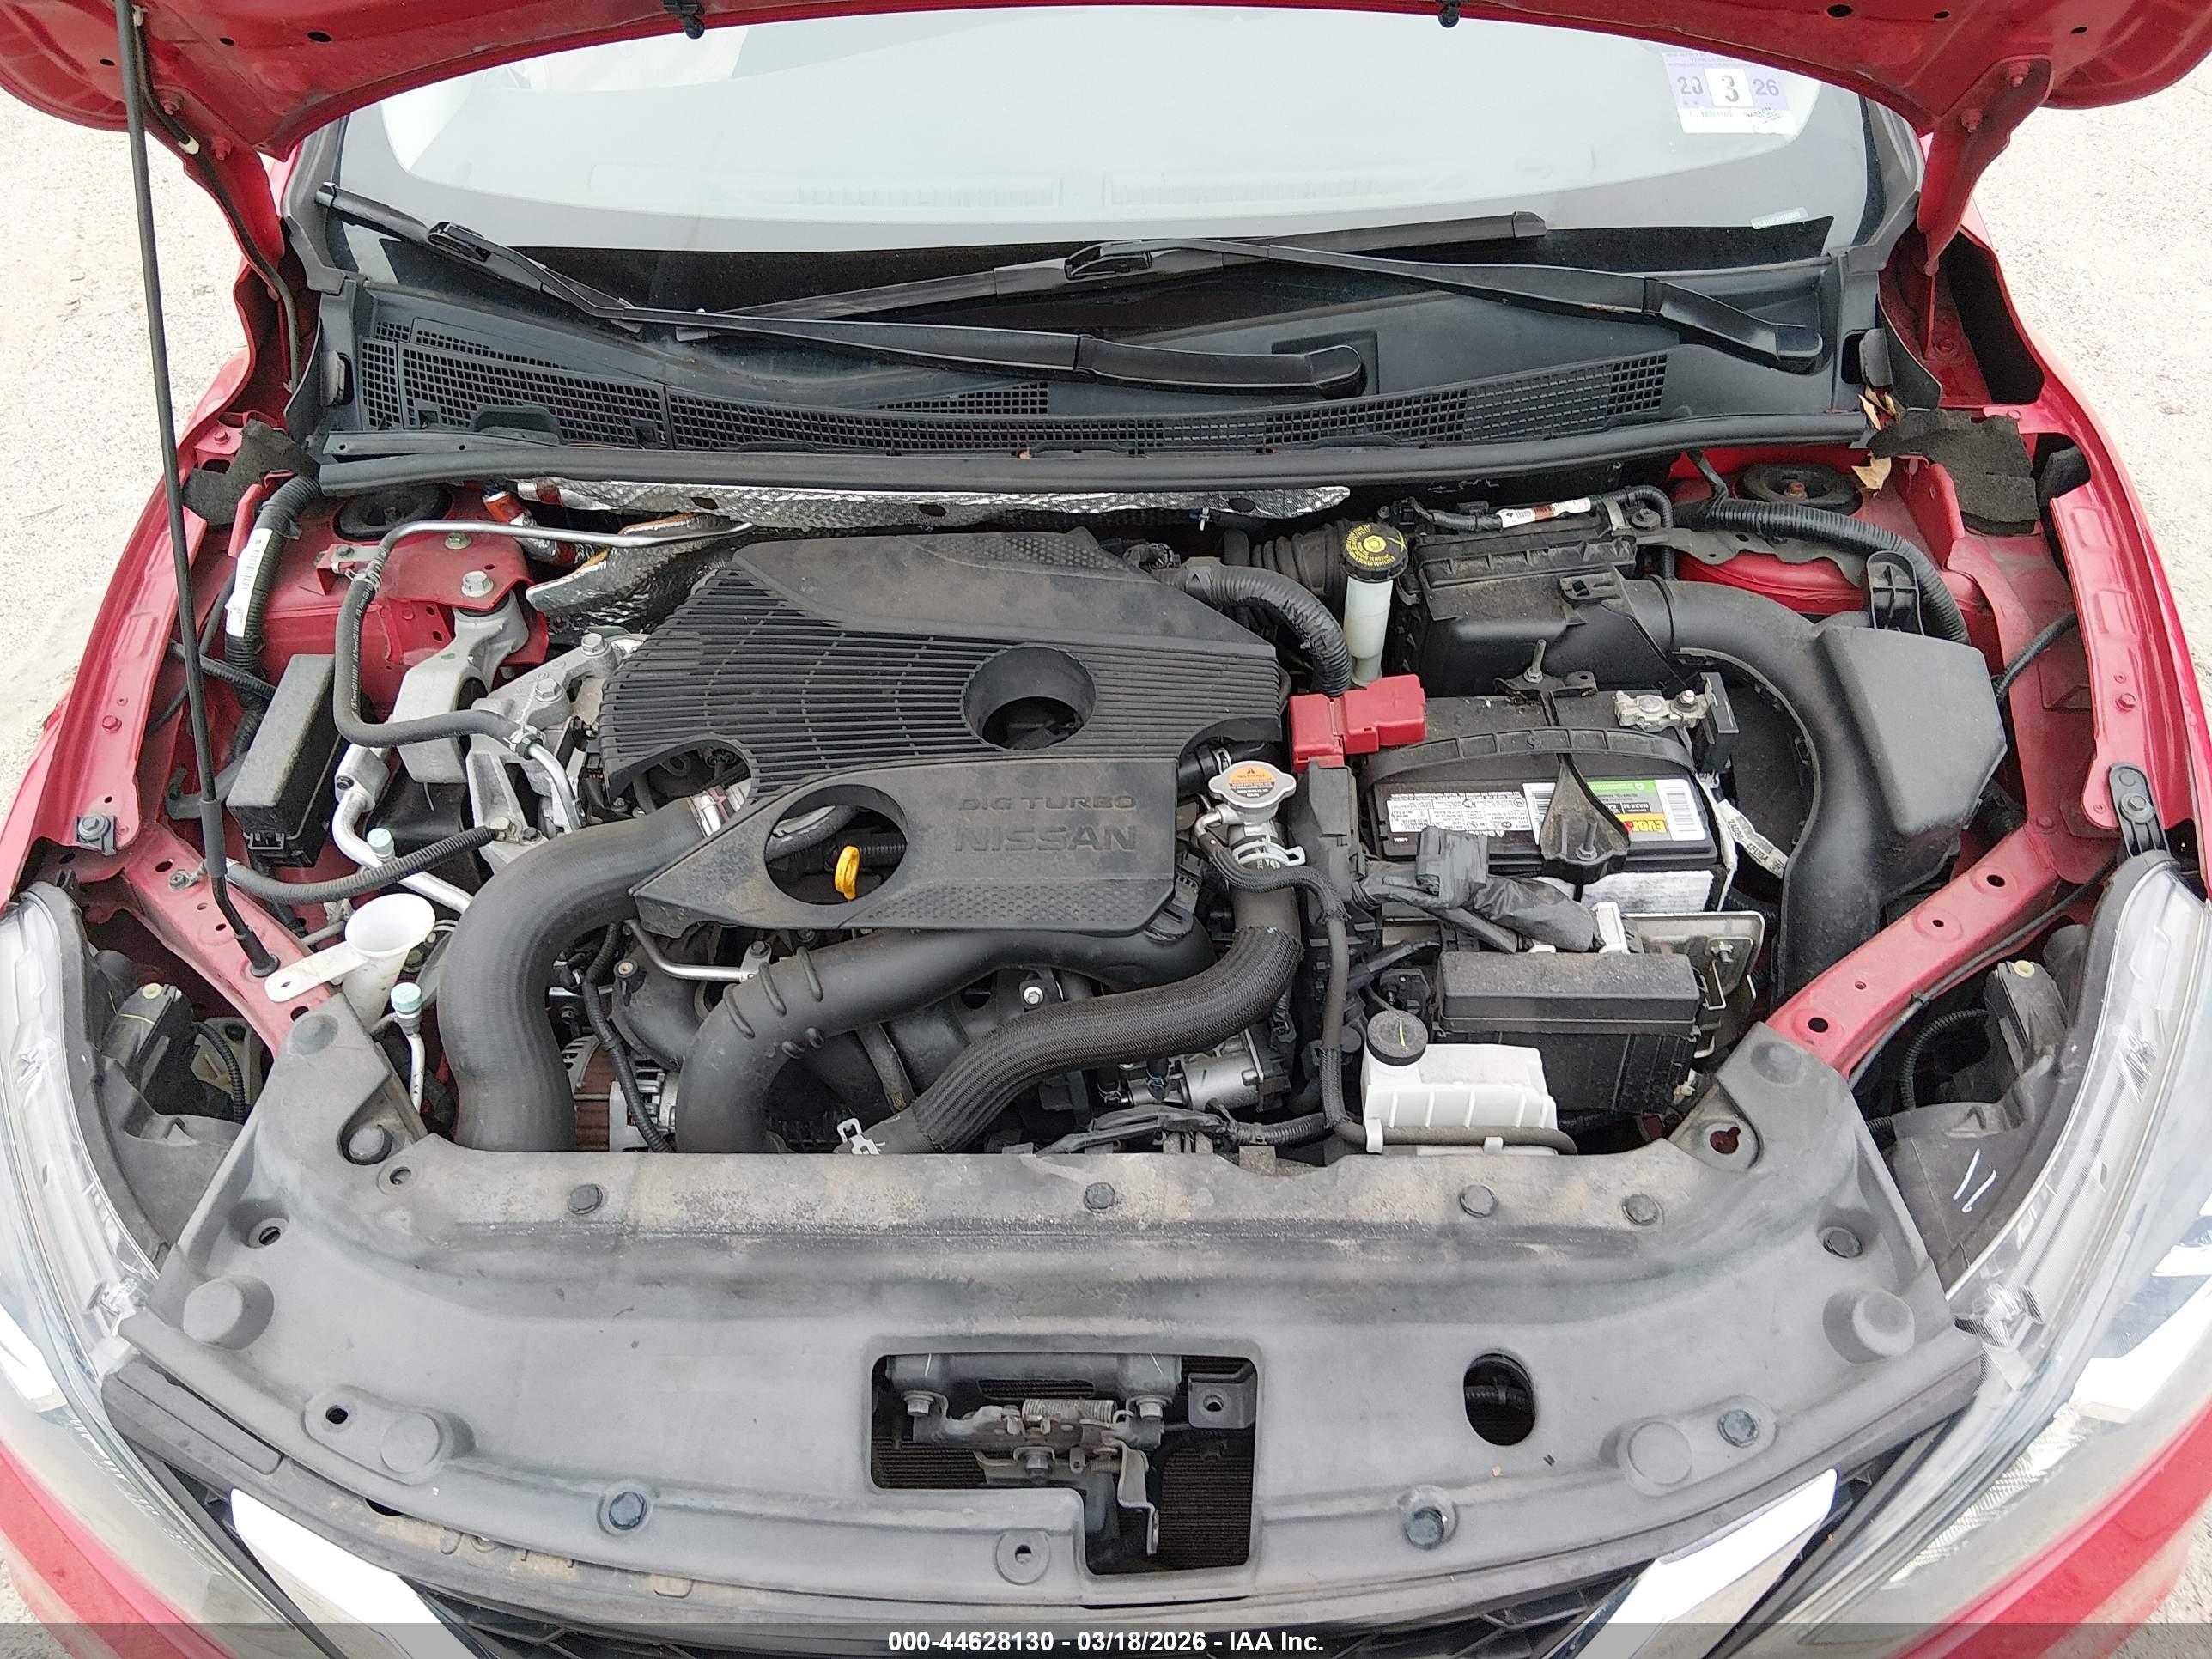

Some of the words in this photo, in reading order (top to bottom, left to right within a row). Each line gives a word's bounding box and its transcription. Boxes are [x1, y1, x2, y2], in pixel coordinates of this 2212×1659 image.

[1721, 76, 1740, 102] 3
[1753, 78, 1780, 96] 26
[959, 797, 1012, 811] DIG
[1020, 794, 1138, 811] TURBO
[954, 825, 1138, 853] NISSAN
